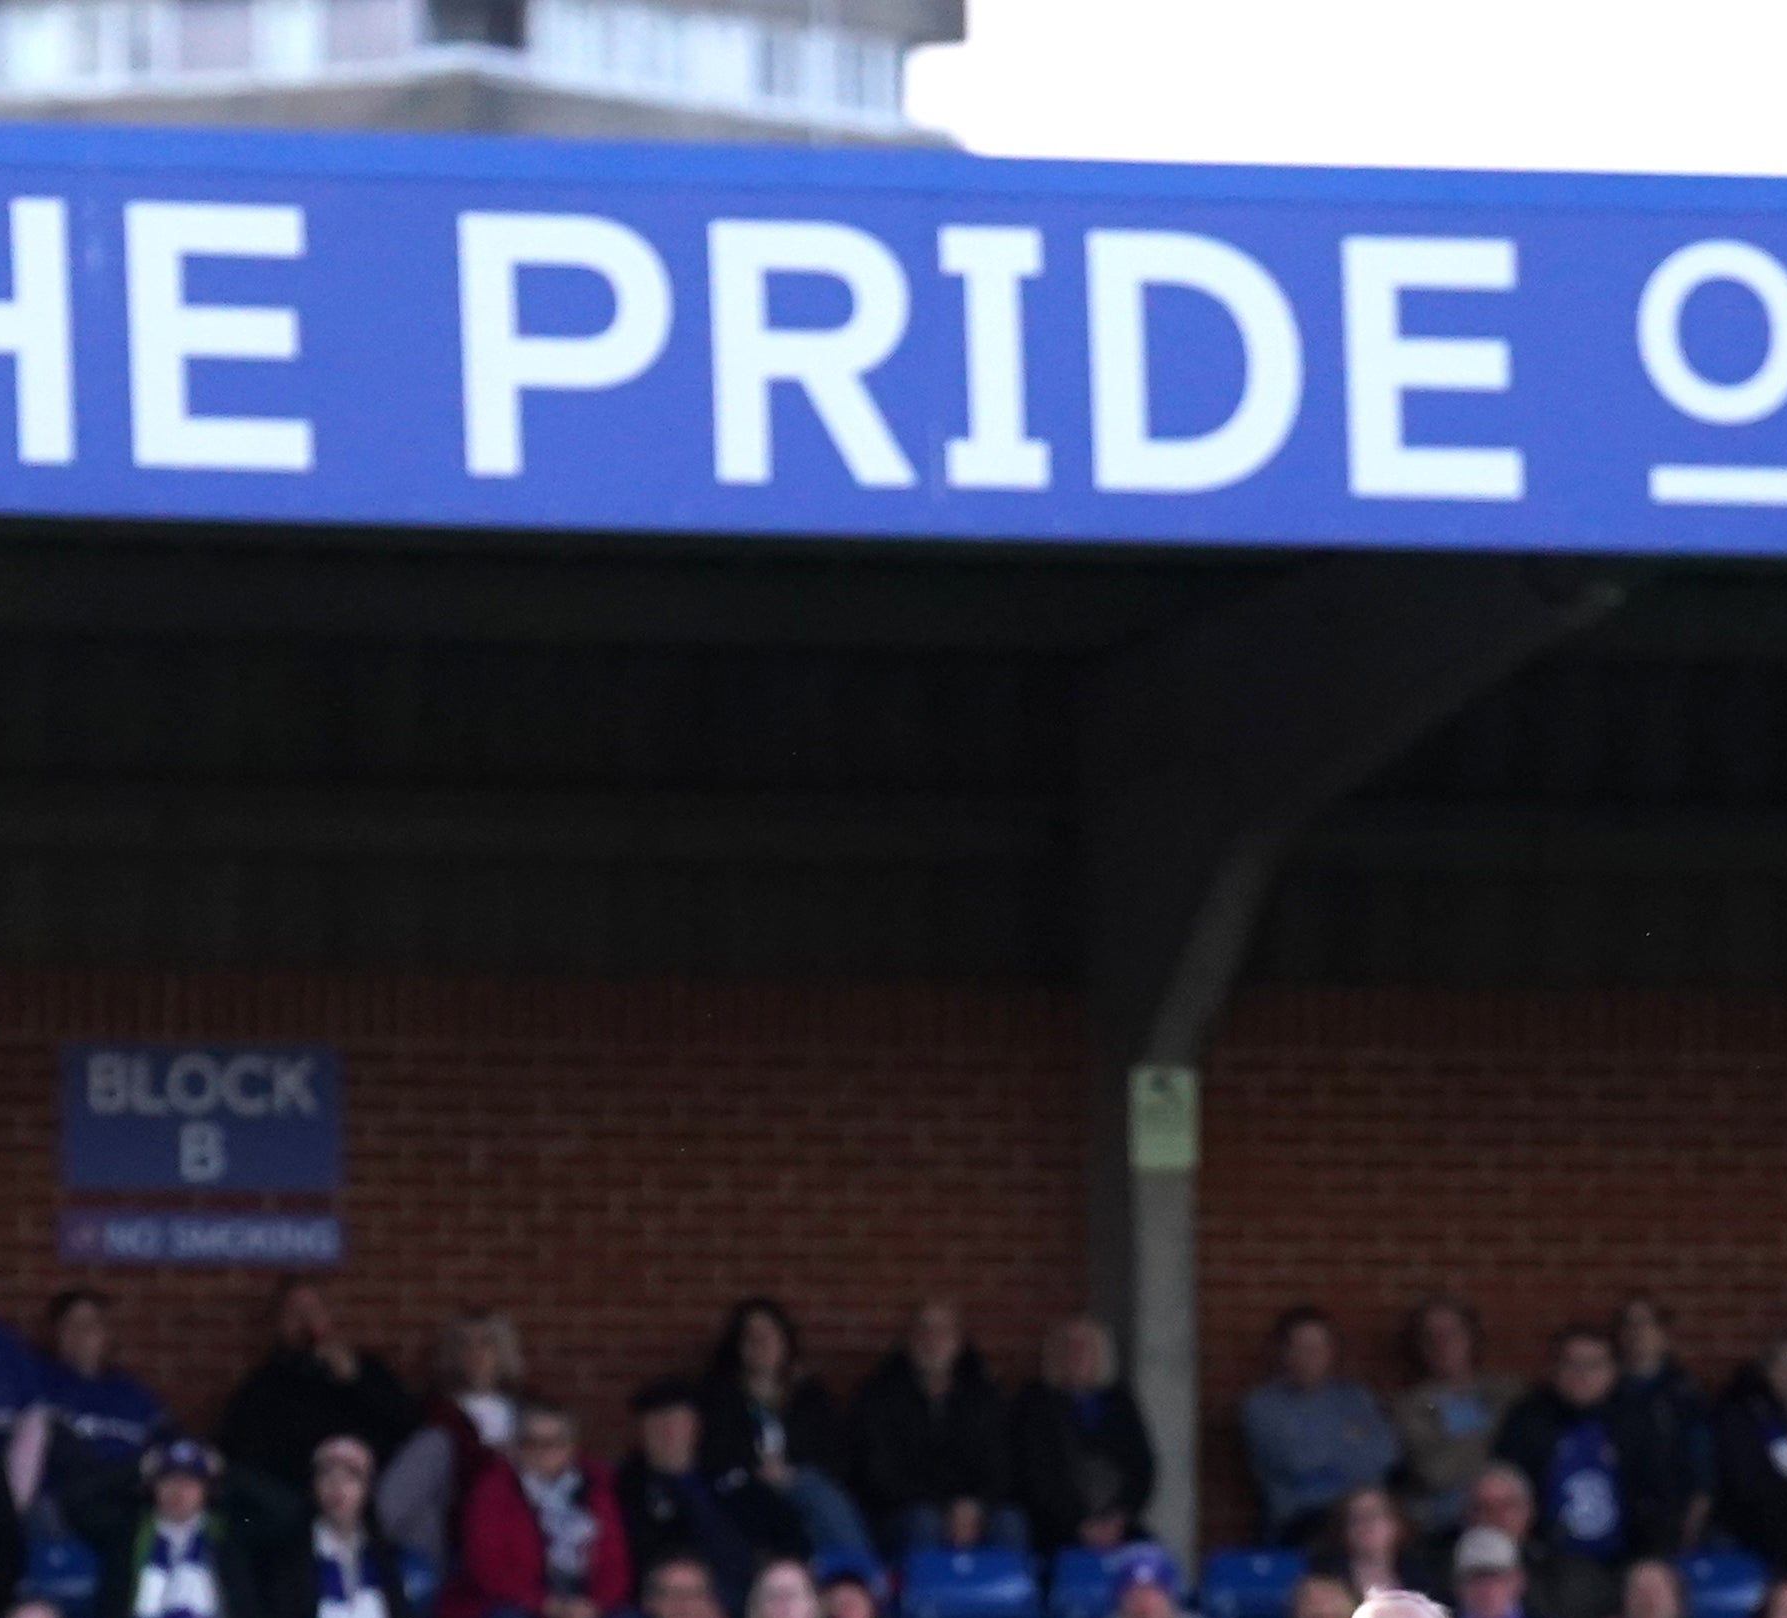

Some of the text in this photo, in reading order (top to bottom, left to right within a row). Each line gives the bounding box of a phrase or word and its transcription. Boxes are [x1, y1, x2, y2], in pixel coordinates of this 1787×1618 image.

[456, 212, 1525, 499] PRIDE
[87, 1053, 317, 1117] BLOCK
[180, 1121, 226, 1183] B
[103, 1217, 340, 1258] NO SMOKING
